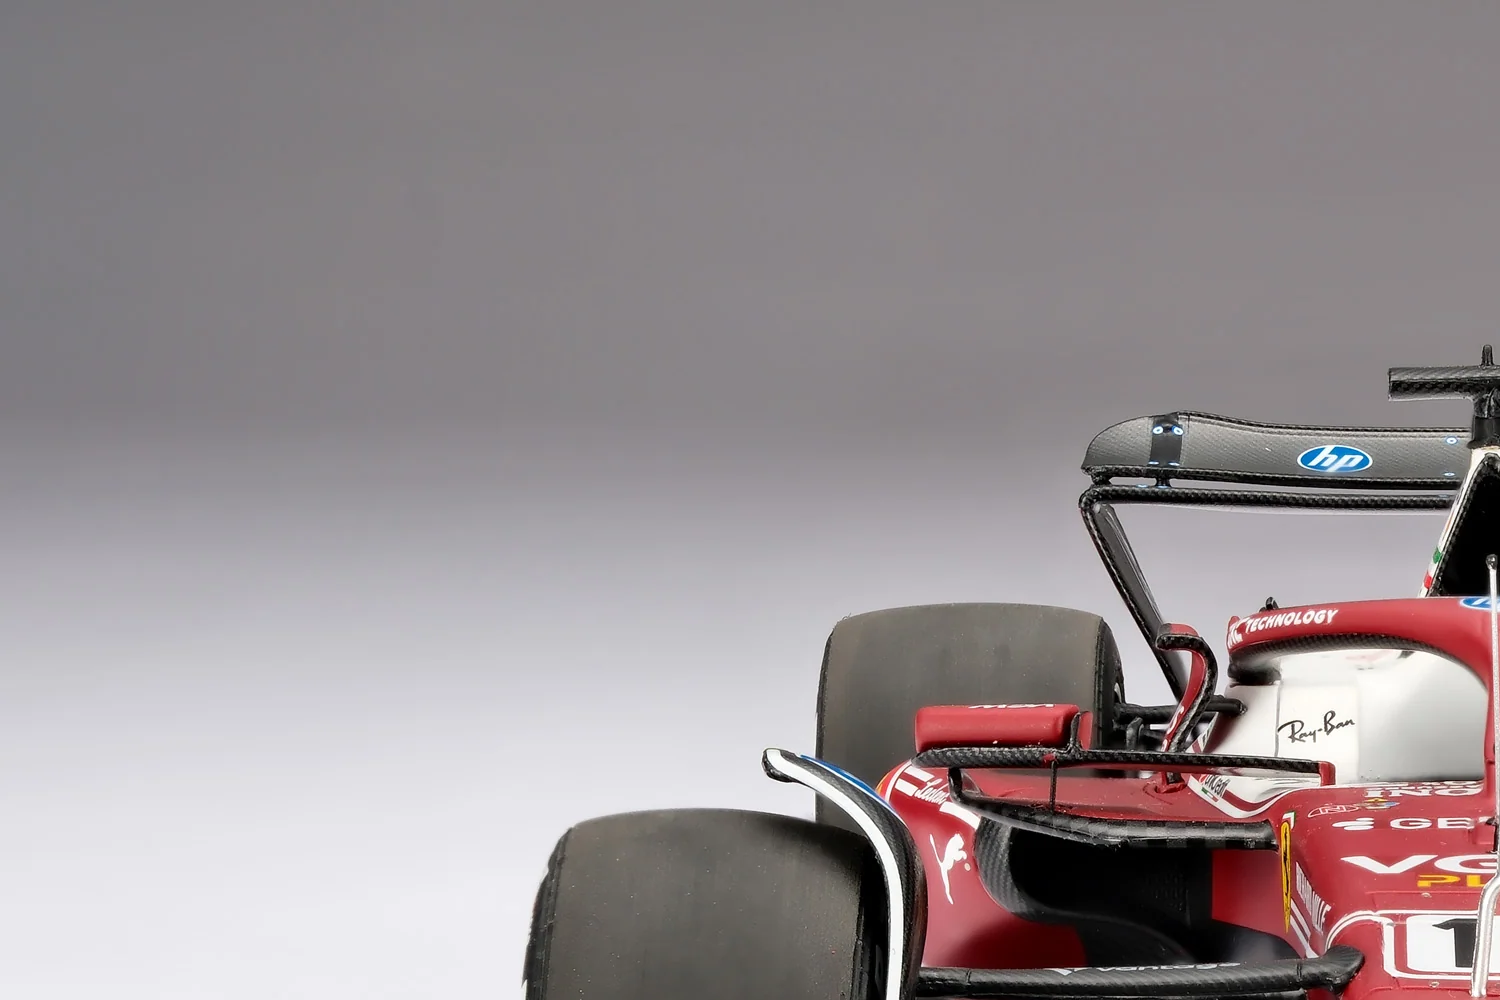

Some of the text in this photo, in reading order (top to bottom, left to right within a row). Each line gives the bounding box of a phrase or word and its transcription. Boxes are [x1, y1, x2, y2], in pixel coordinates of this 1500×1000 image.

[1307, 445, 1364, 472] hp
[1245, 609, 1339, 634] TECHNOLOGY
[1278, 710, 1355, 743] Ray-Ban
